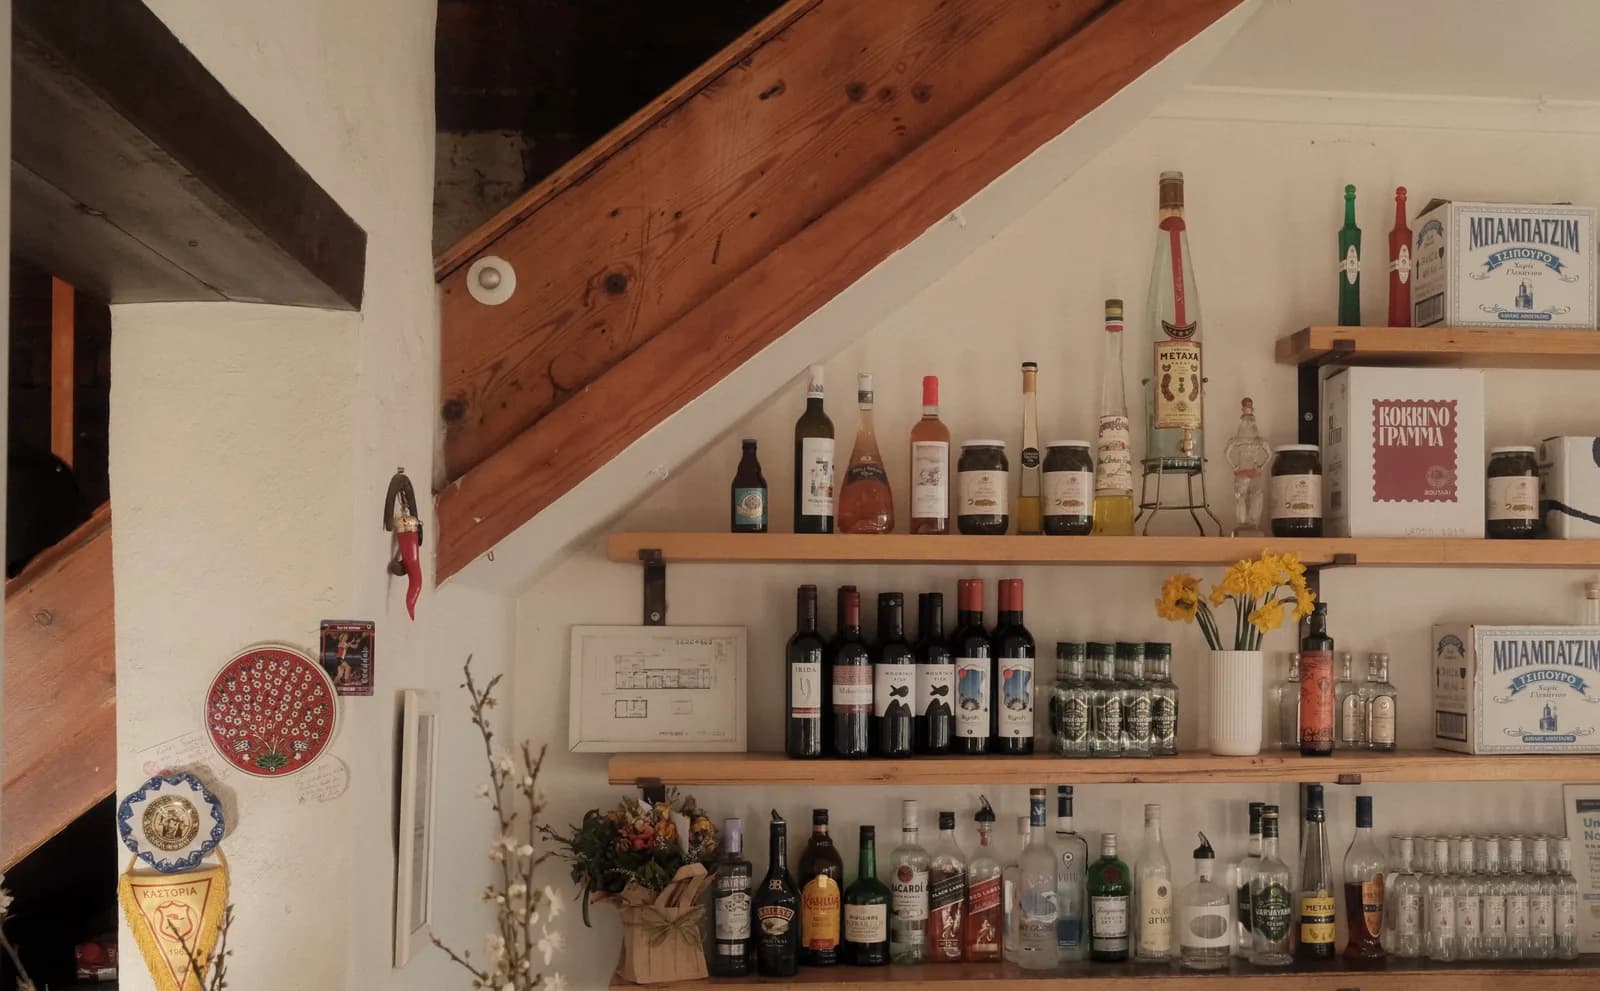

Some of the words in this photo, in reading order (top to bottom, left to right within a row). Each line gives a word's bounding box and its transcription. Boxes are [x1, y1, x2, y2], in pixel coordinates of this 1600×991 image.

[1469, 217, 1579, 253] ΜΠΑΜΠΑΤΖΙΜ
[1497, 248, 1552, 262] ΤΣΙΠΟΥΡΟ
[1160, 352, 1199, 360] METAXA
[1379, 406, 1450, 427] ΚΟΚΚΙΝΟ
[1379, 426, 1444, 447] ΓΡΑΜΜΑ
[1519, 671, 1576, 684] ΤΣΙΠΟΥΡΟ
[143, 887, 198, 898] ΚΑΣΤΟΡΙΑ
